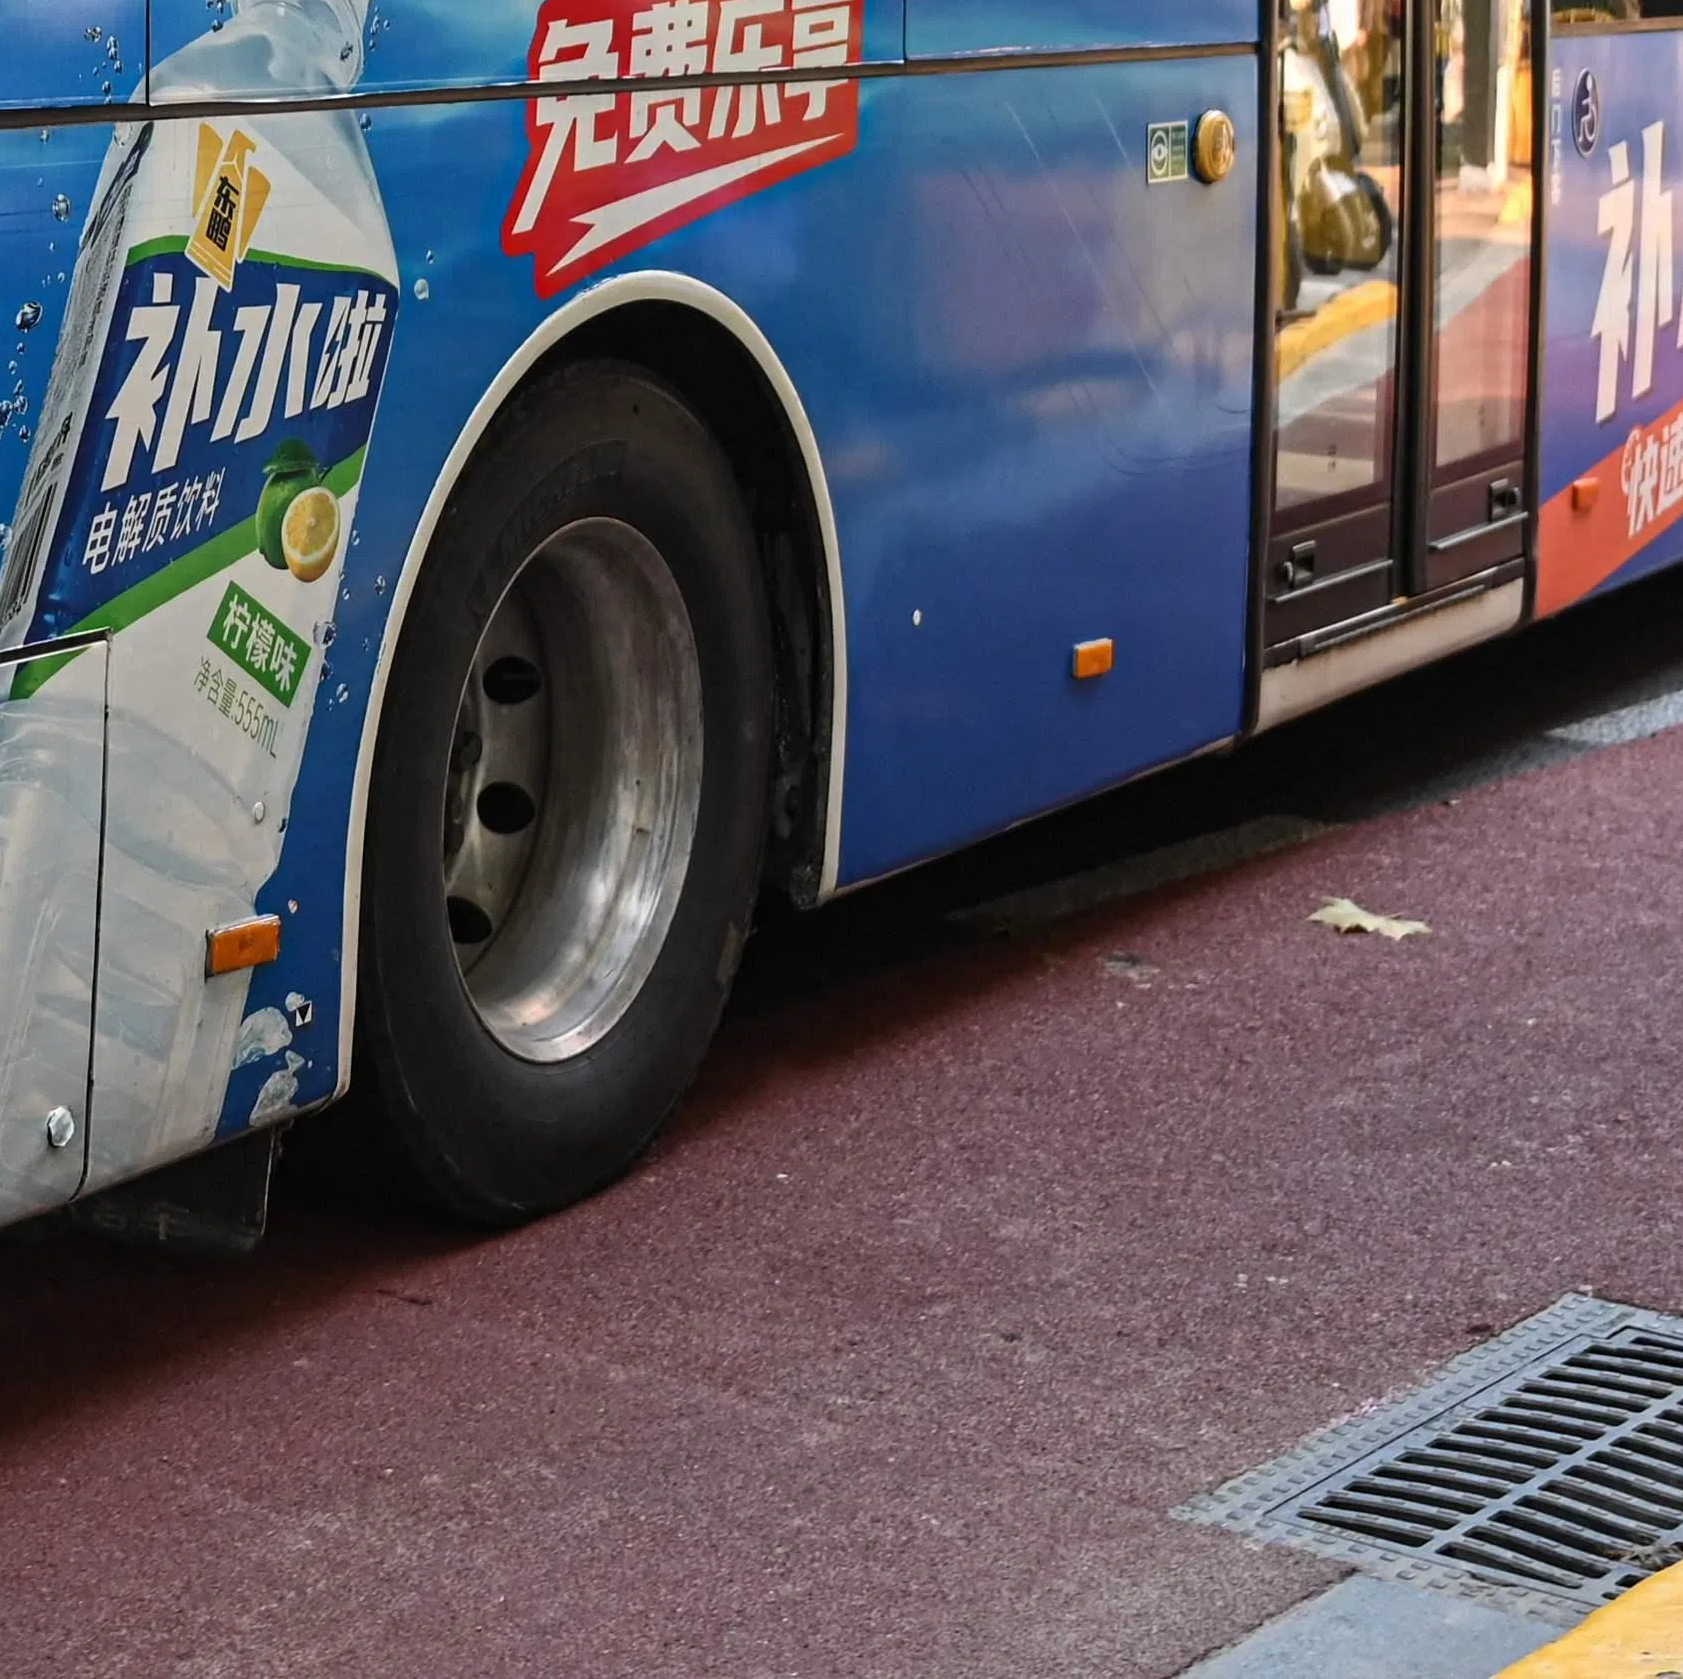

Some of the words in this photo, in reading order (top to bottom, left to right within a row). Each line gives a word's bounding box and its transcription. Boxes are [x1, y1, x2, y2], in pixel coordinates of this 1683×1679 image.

[101, 272, 386, 492] 补水啦
[82, 468, 226, 577] 电解质饮料
[222, 593, 299, 694] 柠檬味
